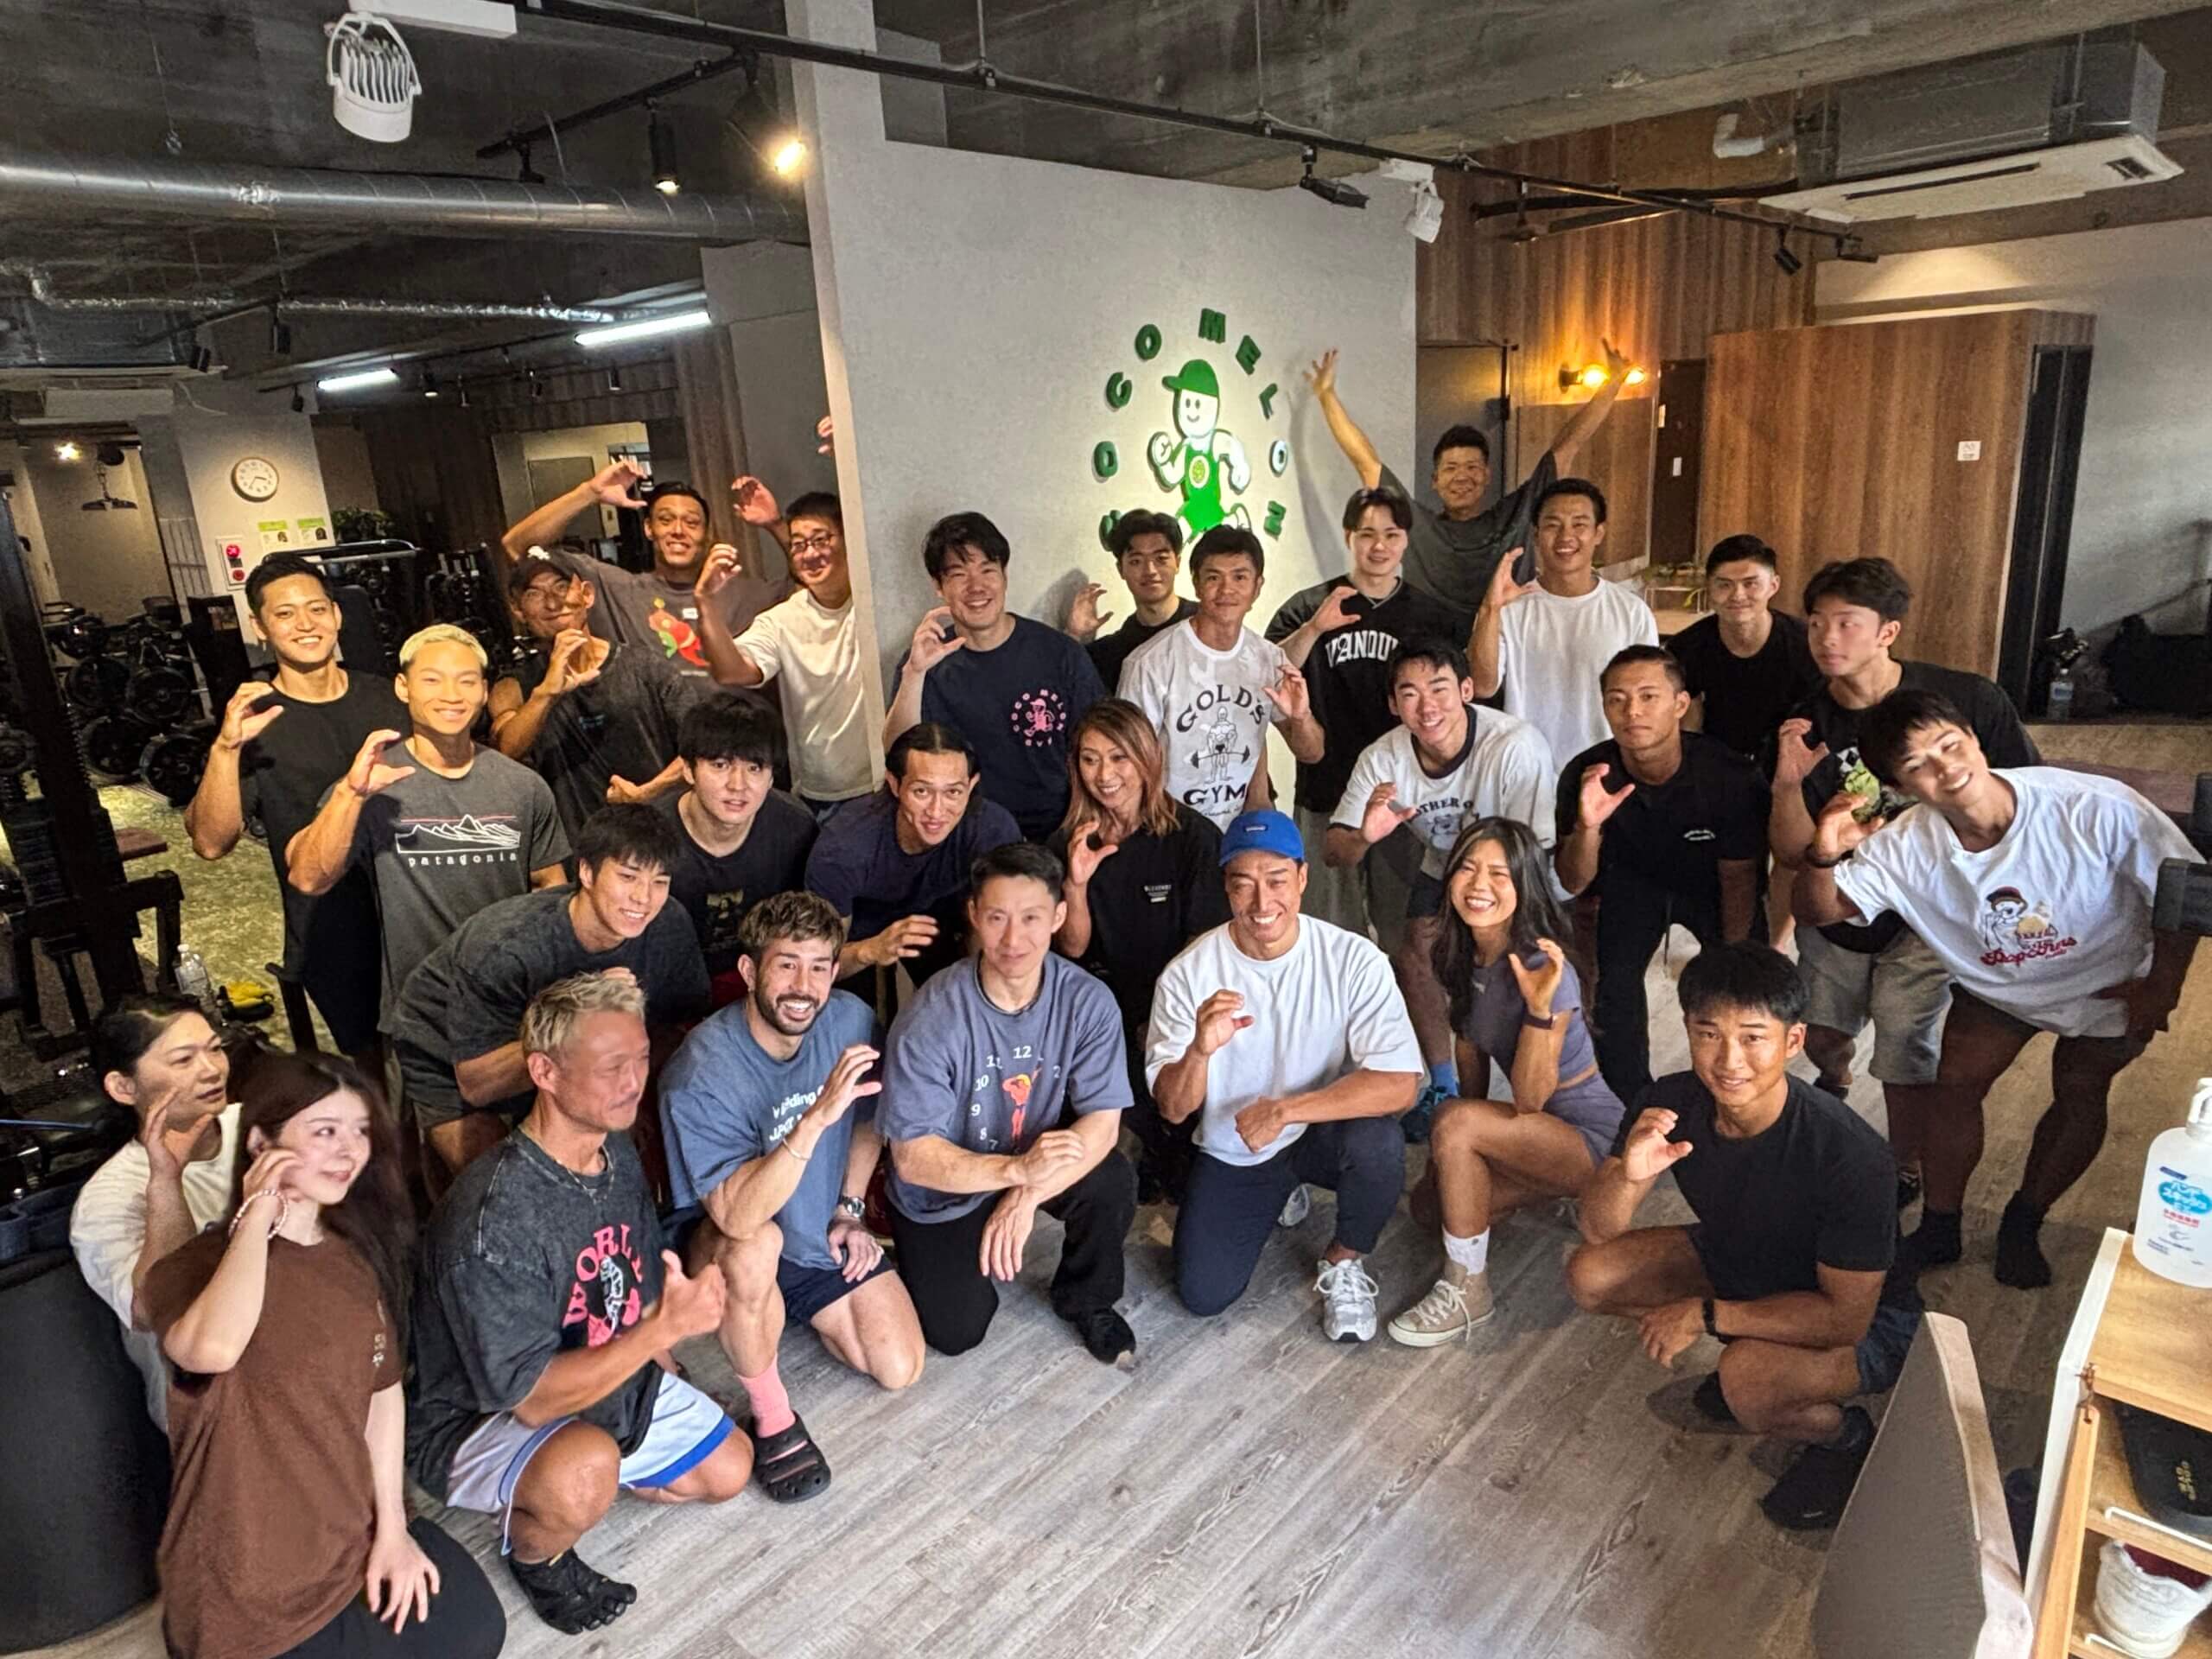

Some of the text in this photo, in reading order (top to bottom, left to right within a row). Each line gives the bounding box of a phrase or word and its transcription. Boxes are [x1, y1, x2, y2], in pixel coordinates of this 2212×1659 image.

[1176, 684, 1265, 733] GOLD'S
[1183, 783, 1247, 805] GYM
[408, 852, 518, 868] patagonia
[1013, 1045, 1033, 1059] 12
[975, 1074, 989, 1091] 10
[970, 1103, 981, 1116] 9
[979, 1127, 988, 1141] 8
[988, 1139, 998, 1150] 7
